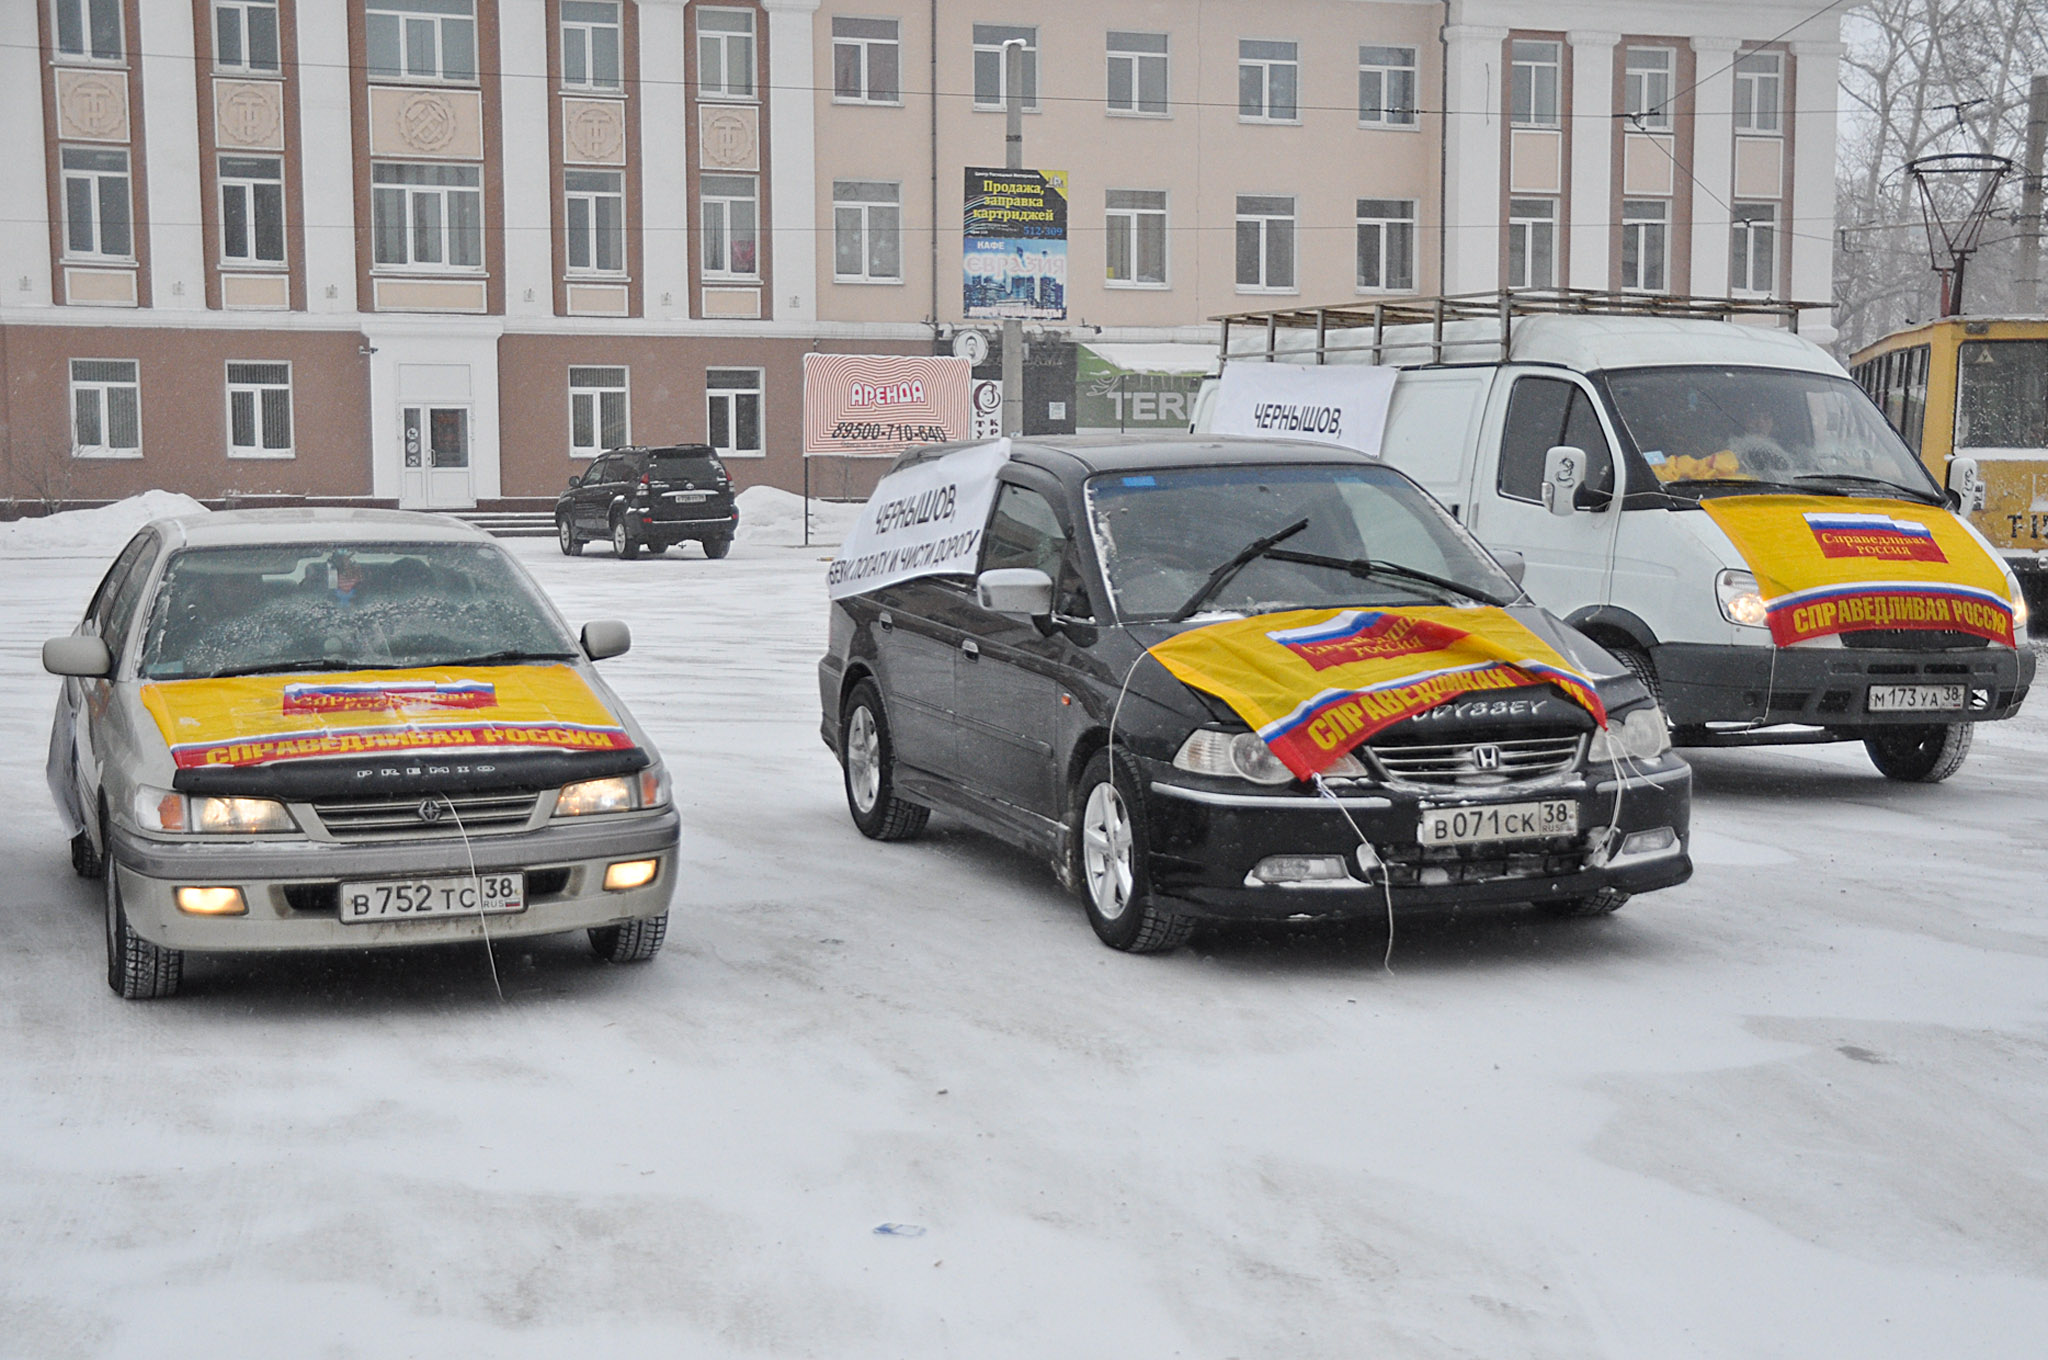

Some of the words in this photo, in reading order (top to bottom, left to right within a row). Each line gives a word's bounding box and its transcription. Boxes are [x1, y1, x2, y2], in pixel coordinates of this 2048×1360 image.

[983, 180, 1045, 195] Продажа,
[983, 196, 1044, 209] заправка
[972, 209, 1054, 222] картриджей
[1023, 226, 1063, 236] 512-309
[977, 241, 1005, 250] КАФЕ
[850, 379, 926, 406] АРЕНДА
[1254, 402, 1342, 439] ЧЕРНЫШОВ,
[875, 483, 957, 535] ЧЕРНЫШОВ,
[930, 529, 981, 568] ДОРОГУ
[1792, 595, 1950, 634] СПРАВЕДЛИВАЯ
[1951, 599, 2007, 636] РОССИЯ
[1943, 686, 1959, 701] 38
[205, 729, 476, 765] СПРАВЕДЛИВАЯ
[484, 728, 614, 747] РОССИЯ
[356, 765, 496, 778] PREMIO
[1543, 803, 1568, 823] 38
[484, 877, 513, 898] 38
[483, 899, 504, 908] RUS
